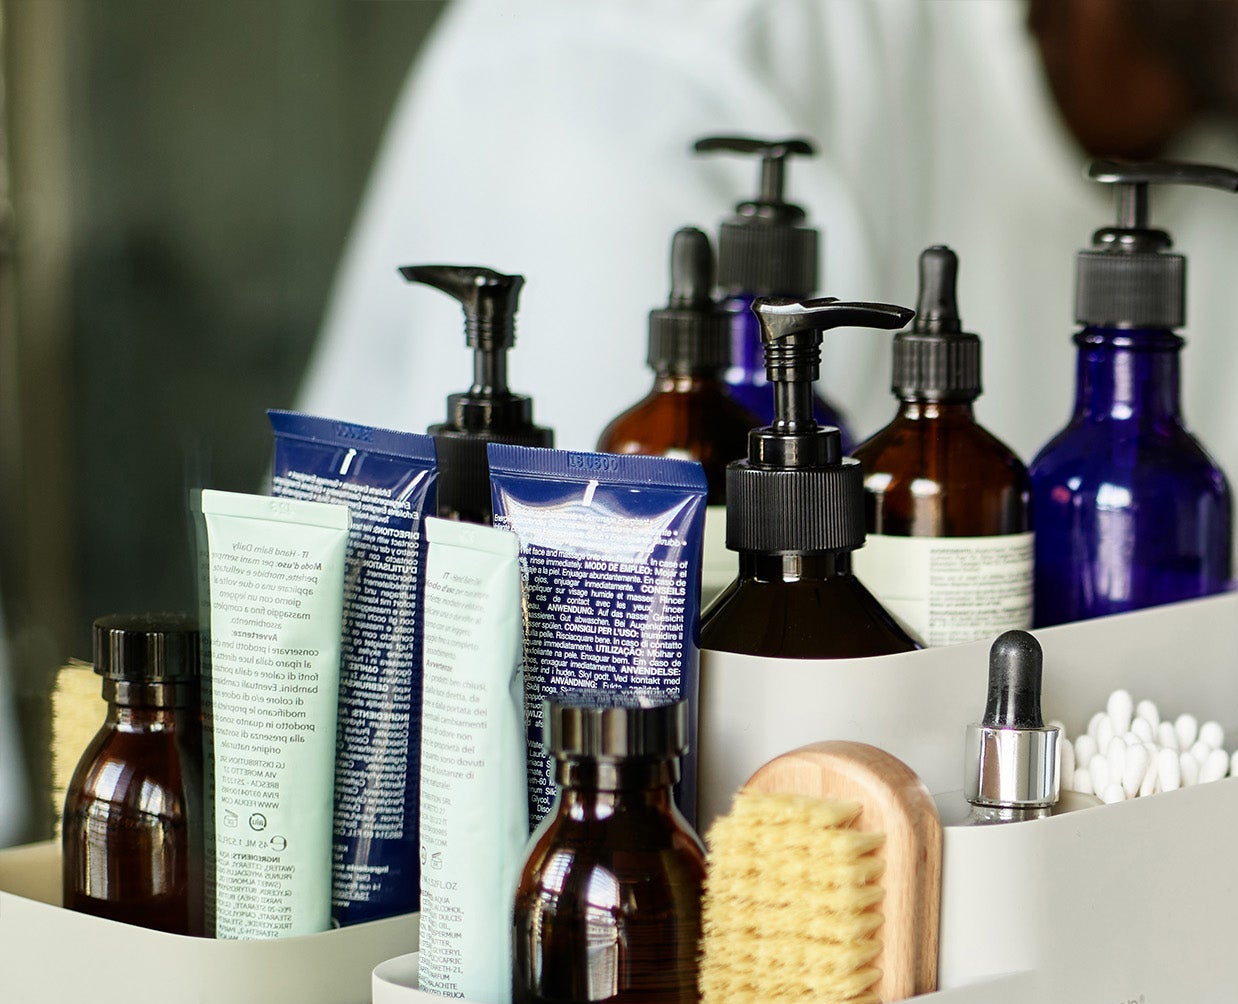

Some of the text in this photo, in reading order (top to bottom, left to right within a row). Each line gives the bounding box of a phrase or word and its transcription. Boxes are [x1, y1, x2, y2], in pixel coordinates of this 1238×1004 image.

[532, 547, 545, 556] face
[529, 556, 544, 564] rinse
[584, 561, 607, 571] MODO
[607, 564, 618, 572] DE
[542, 566, 548, 574] la
[561, 568, 588, 580] Enjuagar
[643, 576, 654, 584] En
[675, 578, 686, 586] de
[553, 578, 580, 588] enjuagar
[640, 584, 685, 595] CONSEILS
[552, 594, 561, 602] de
[566, 597, 589, 605] contact
[616, 600, 626, 609] les
[568, 587, 588, 598] visage
[590, 589, 614, 598] humide
[659, 595, 685, 604] Rincer
[559, 613, 571, 622] Gut
[614, 618, 625, 627] Bei
[597, 608, 609, 616] Auf
[610, 609, 623, 618] das
[652, 613, 684, 623] Gesicht
[563, 623, 596, 633] CONSIGLI
[597, 626, 612, 635] PER
[555, 631, 594, 643] Risciacquare
[613, 637, 620, 645] In
[640, 639, 648, 647] di
[649, 641, 682, 650] contatto
[580, 652, 610, 663] Enxaguar
[632, 657, 646, 665] Em
[671, 660, 681, 668] de
[647, 649, 674, 658] Molhar
[540, 658, 568, 668] enxaguar
[540, 665, 550, 674] ind
[578, 670, 592, 680] Skyl
[613, 673, 627, 682] Ved
[630, 675, 660, 684] kontakt
